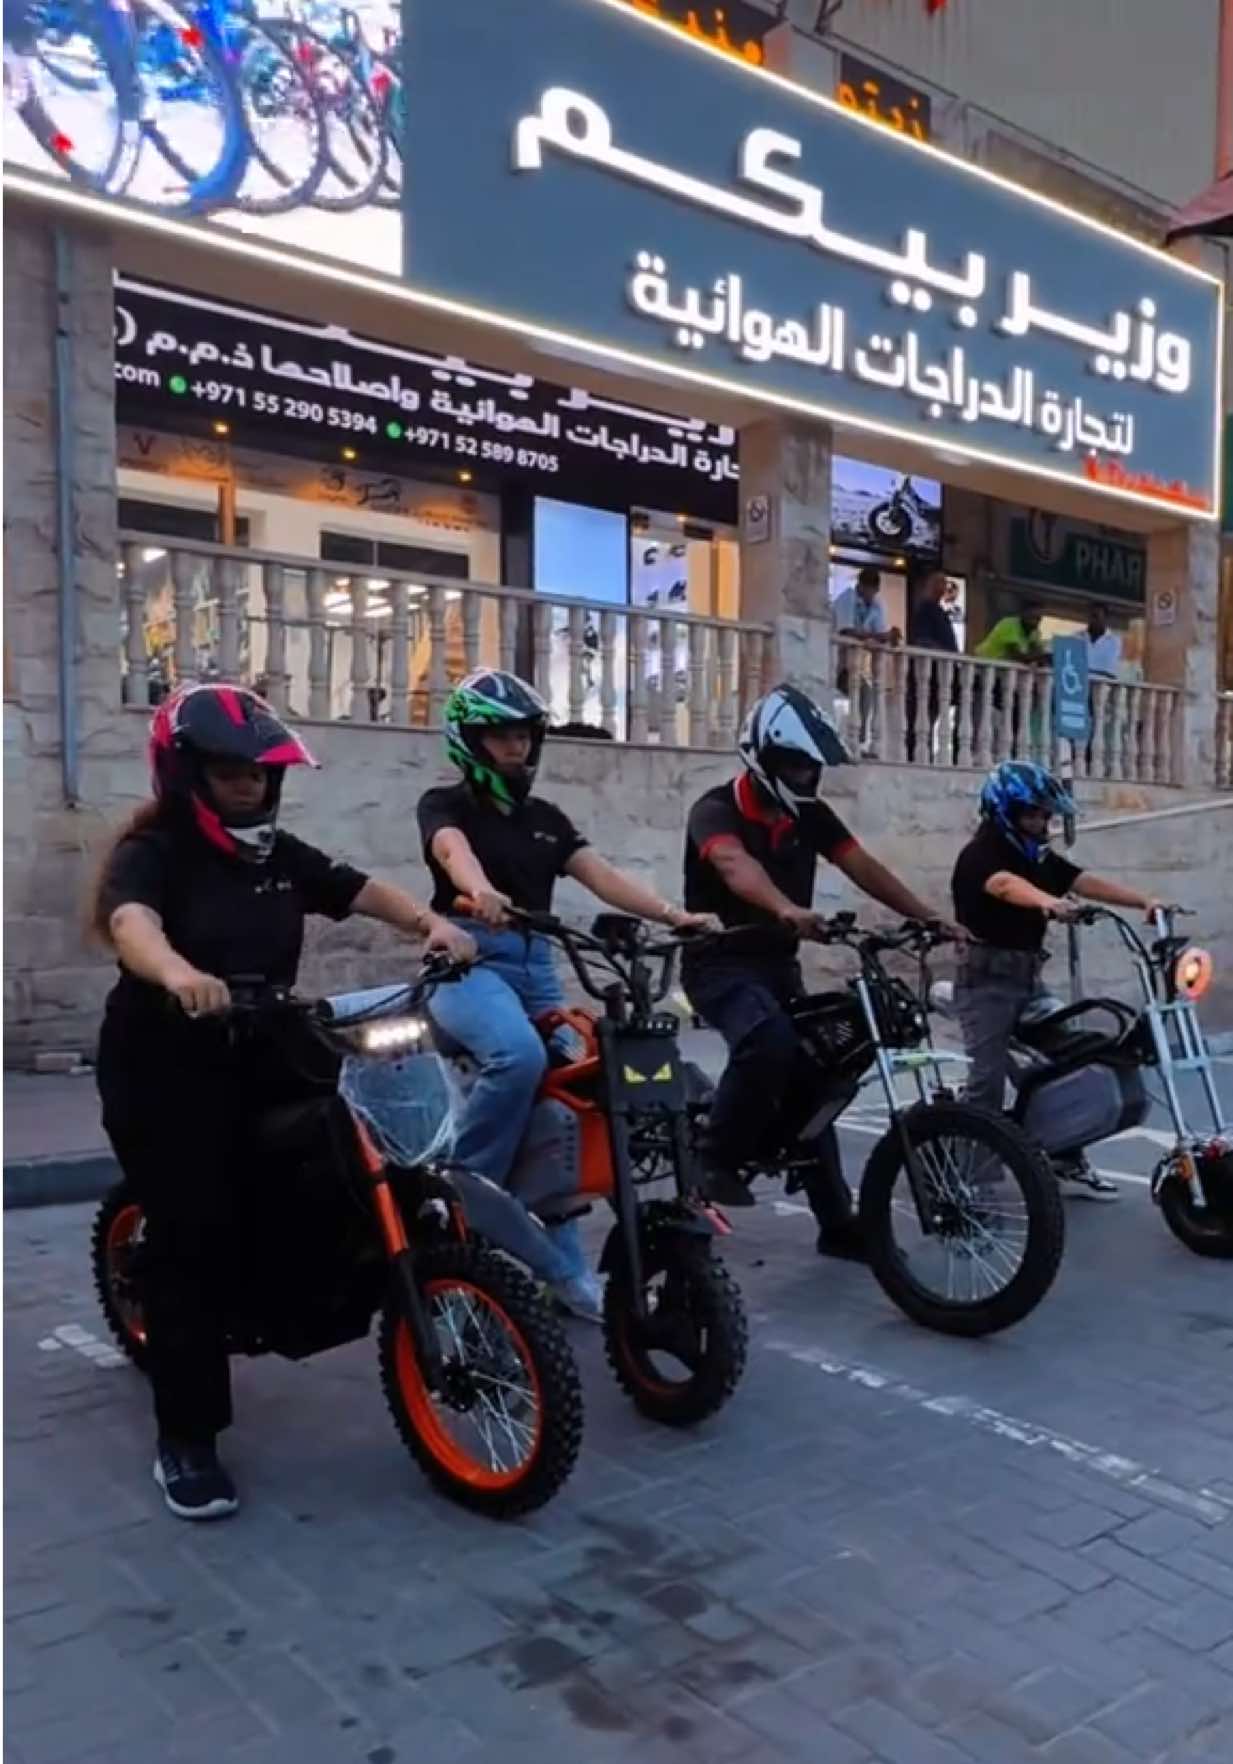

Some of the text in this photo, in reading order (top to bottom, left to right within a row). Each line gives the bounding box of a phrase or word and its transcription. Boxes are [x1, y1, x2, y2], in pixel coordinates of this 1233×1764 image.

[516, 87, 986, 328] بيكم
[190, 378, 246, 407] +971
[252, 391, 280, 415] 55
[284, 396, 324, 423] 290
[327, 407, 379, 433] 5394
[404, 425, 450, 449] +971
[455, 435, 479, 456] 52
[481, 440, 514, 464] 589
[516, 448, 560, 473] 8705
[632, 252, 1133, 459] لتجارة الدراجات الهوائية
[566, 425, 689, 468] الدراجات
